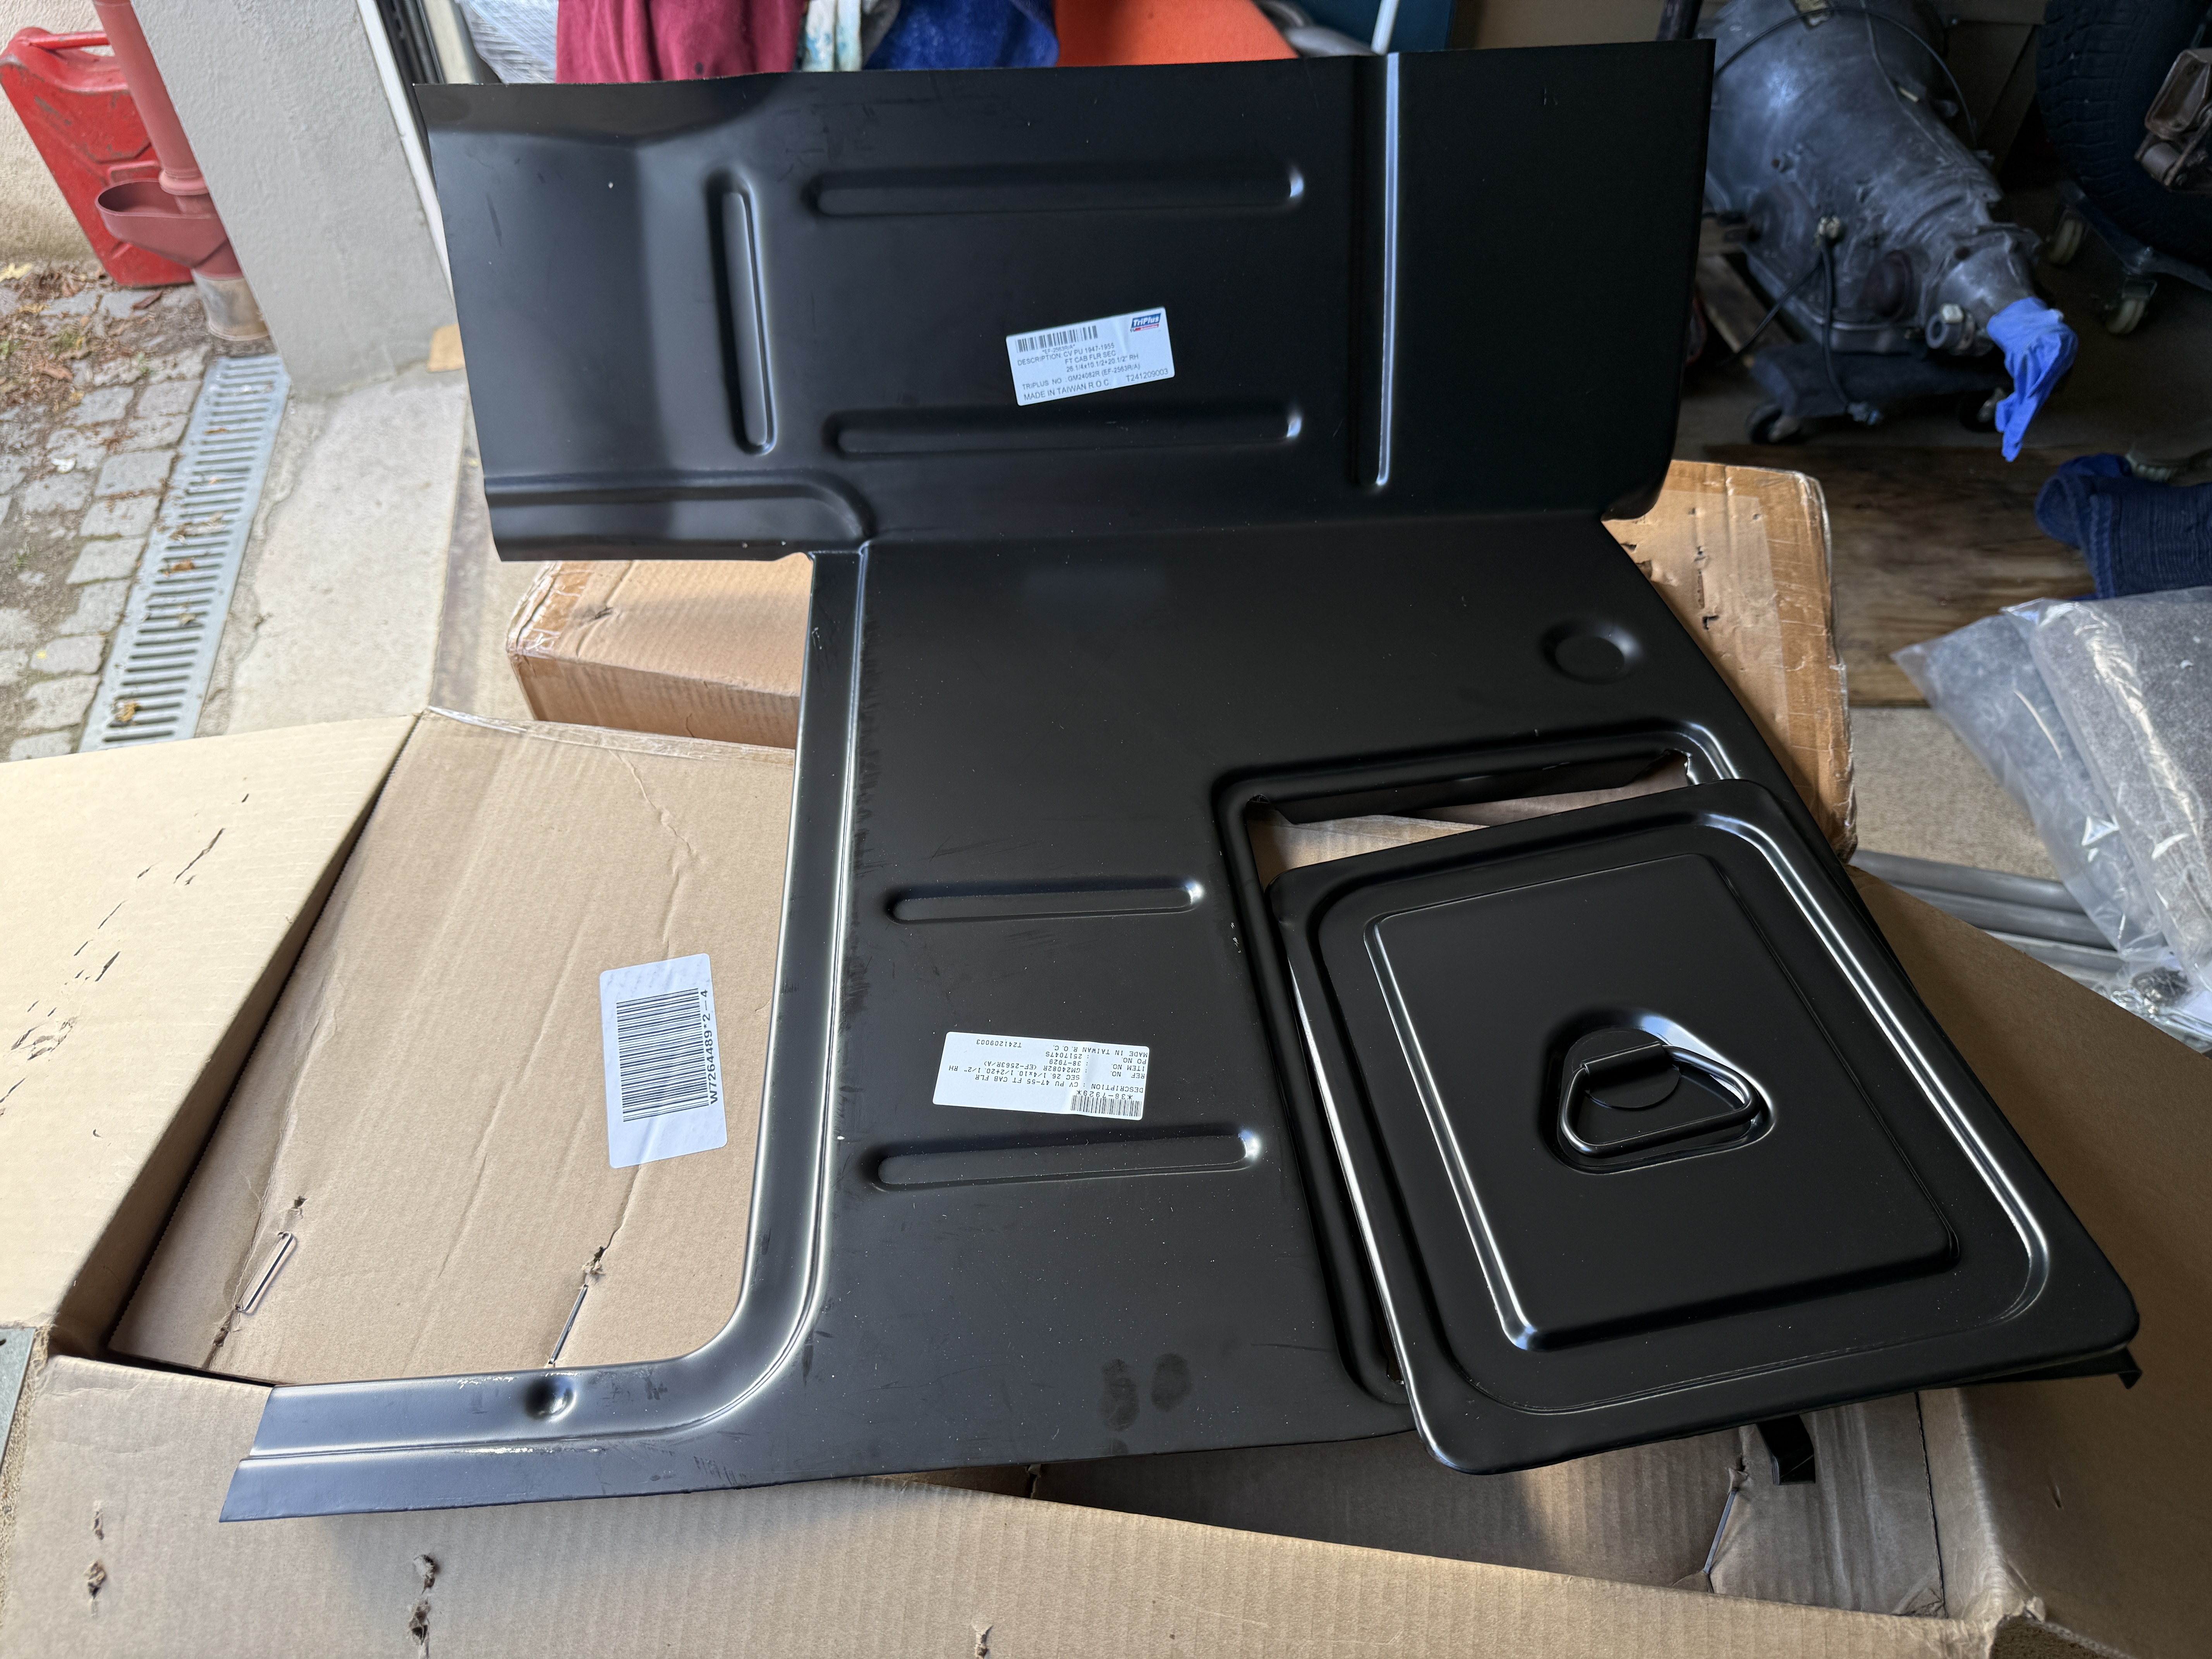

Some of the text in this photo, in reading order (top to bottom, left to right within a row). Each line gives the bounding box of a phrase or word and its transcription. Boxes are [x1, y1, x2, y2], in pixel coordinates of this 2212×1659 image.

[1133, 315, 1159, 327] TriPlus
[1085, 342, 1115, 354] 1947-1955
[1126, 368, 1168, 382] T241209003
[1022, 380, 1049, 390] TRIPLUS
[1024, 391, 1046, 401] MADE
[1057, 383, 1087, 395] TAIWAN
[976, 1039, 1022, 1048] T241209003
[984, 1061, 1037, 1070] (EF-2563R/A)
[1091, 1084, 1143, 1093] DESCRIPTION
